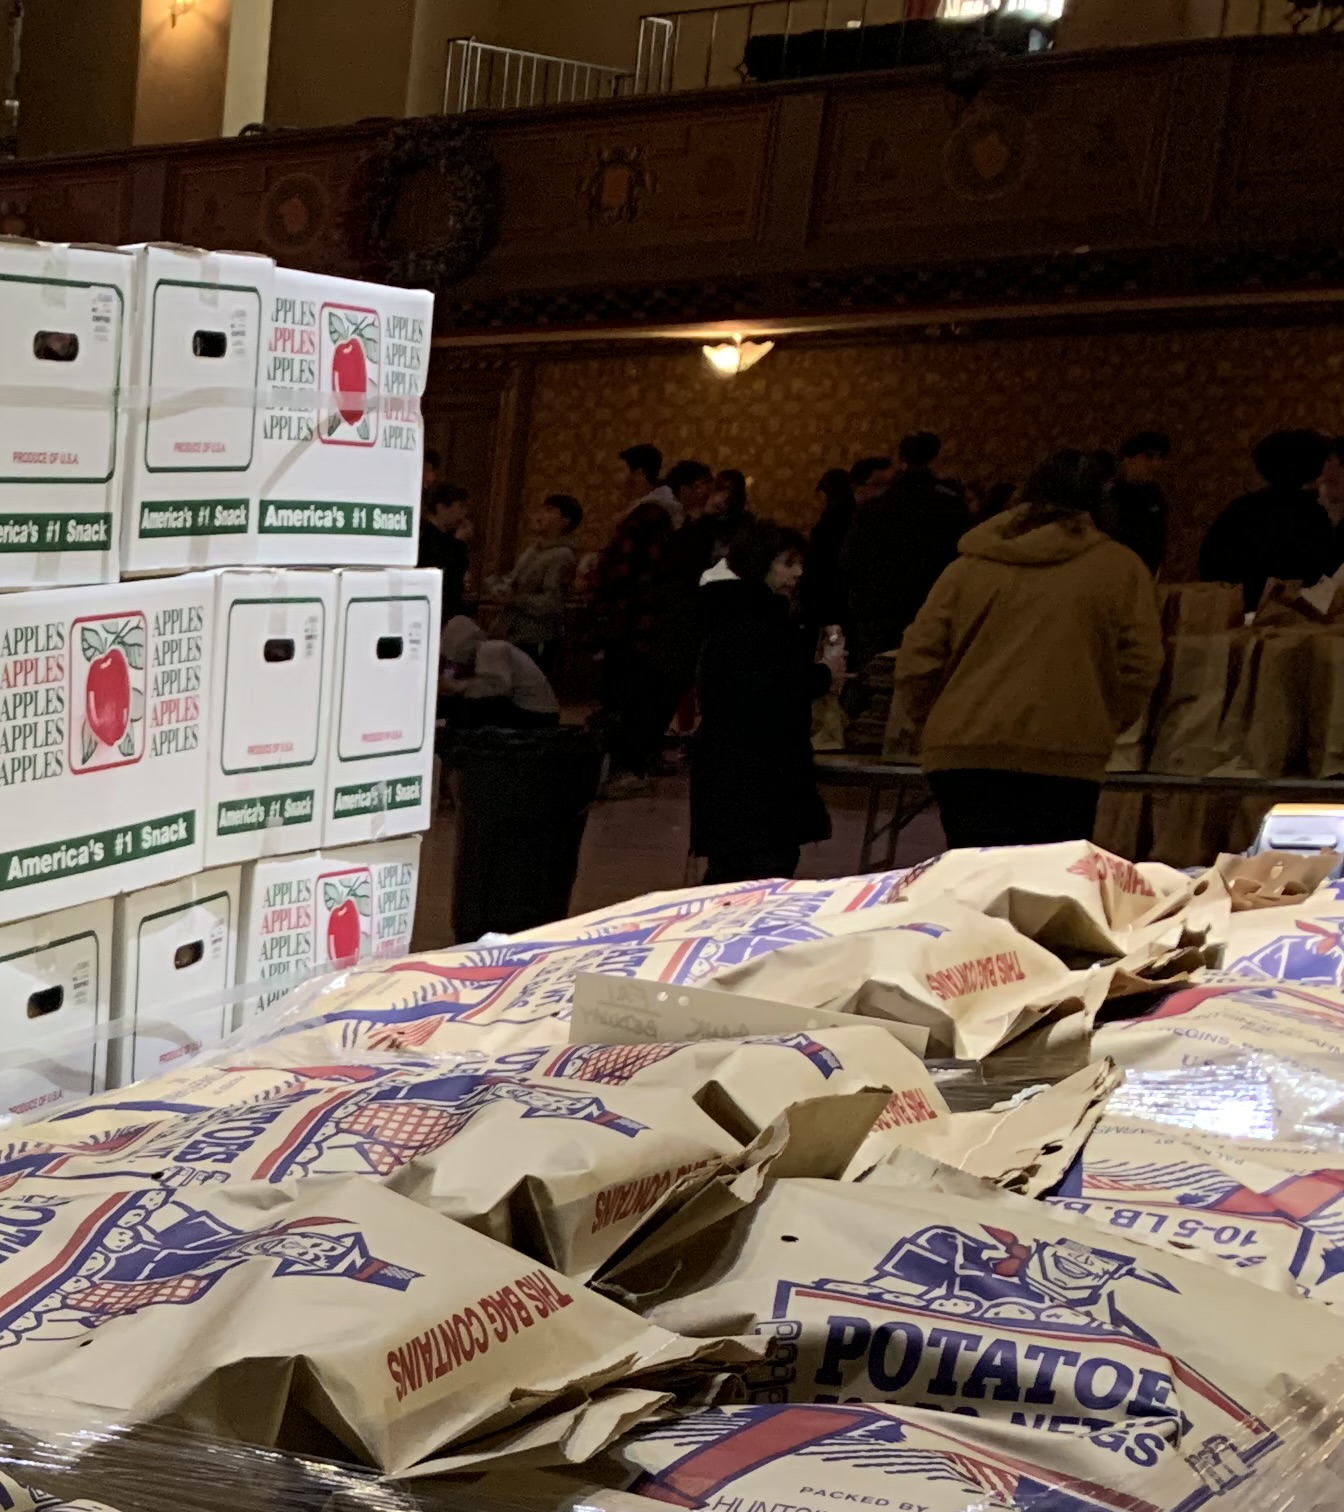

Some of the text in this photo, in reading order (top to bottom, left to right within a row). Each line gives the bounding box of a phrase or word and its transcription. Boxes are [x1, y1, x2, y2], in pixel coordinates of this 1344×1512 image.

[45, 518, 61, 543] #1
[66, 514, 107, 542] Snack
[264, 505, 408, 530] America's #1 Snack
[152, 606, 205, 638] APPLES
[0, 622, 66, 657] APPLES
[152, 636, 203, 668] APPLES
[6, 816, 188, 880] America's #1 Snack
[1104, 1206, 1260, 1247] 10-5 LB.
[387, 1269, 574, 1402] THIS BAG CONTAINS
[815, 1315, 1180, 1418] POTATOE
[799, 1486, 890, 1507] PACKED
